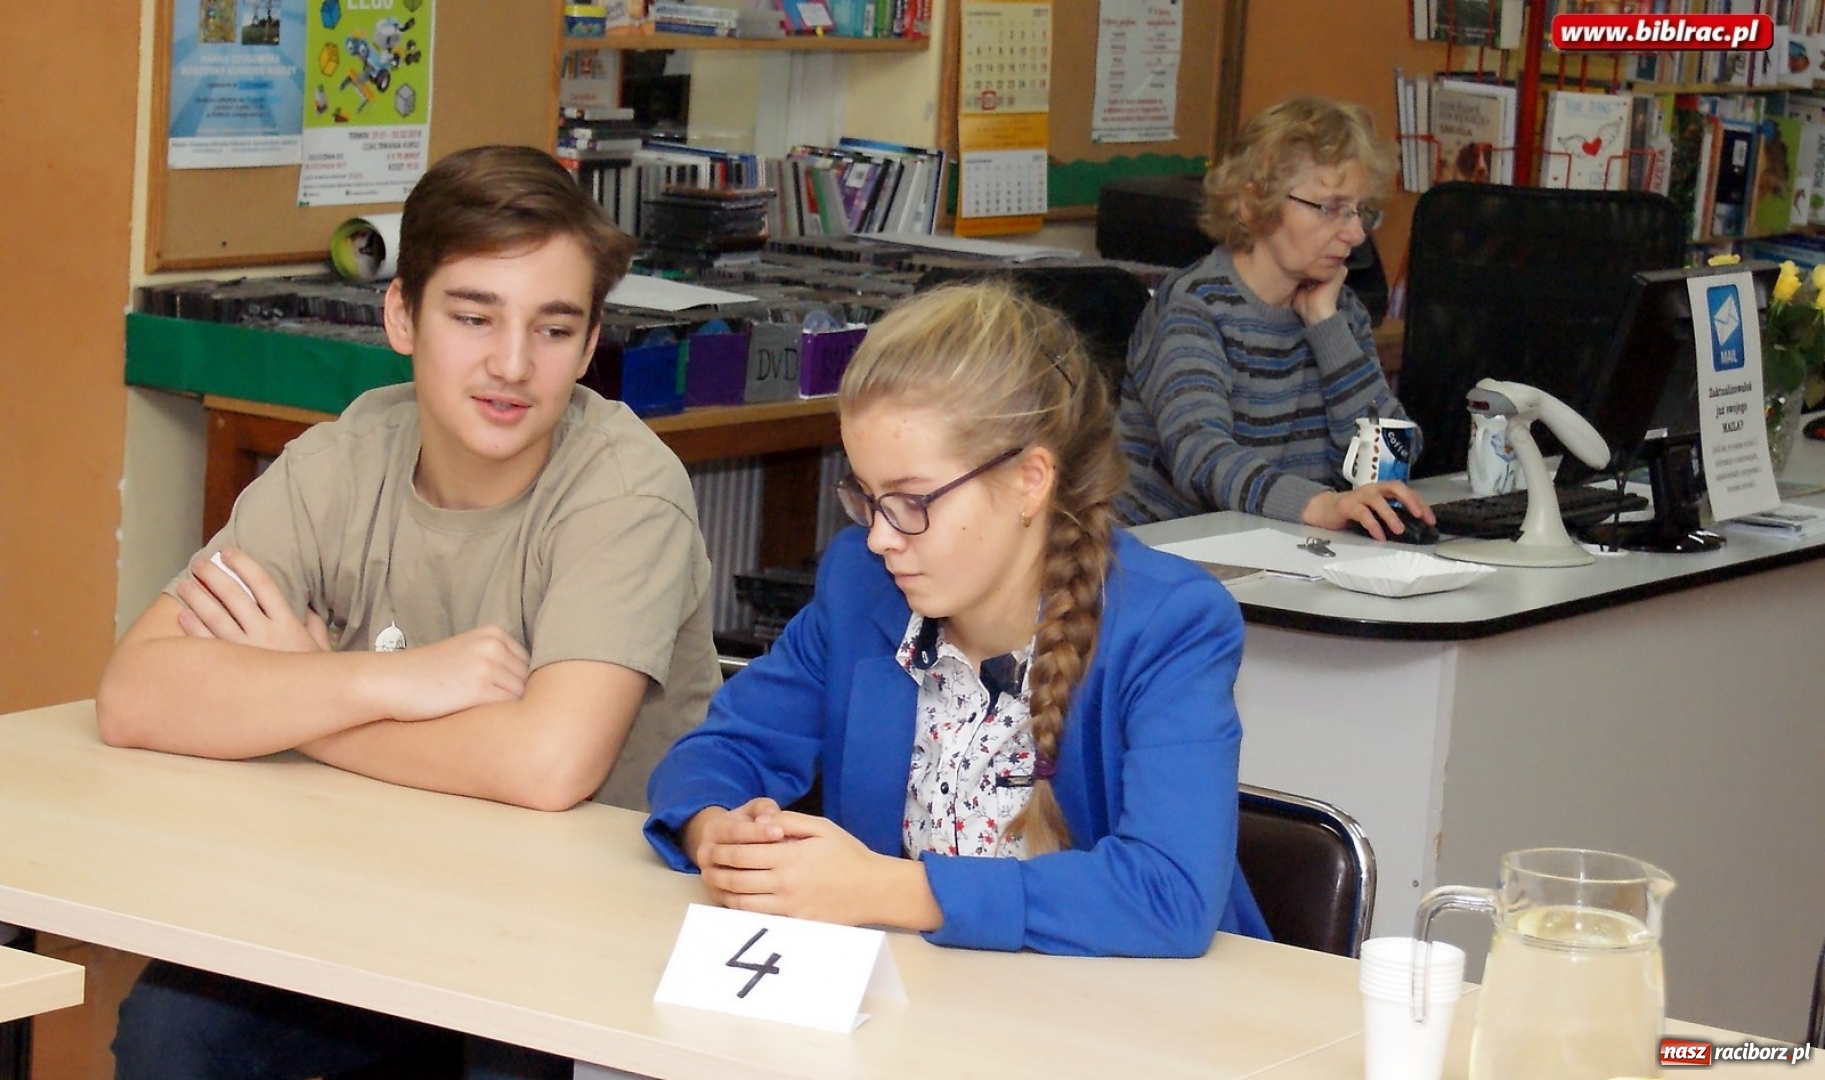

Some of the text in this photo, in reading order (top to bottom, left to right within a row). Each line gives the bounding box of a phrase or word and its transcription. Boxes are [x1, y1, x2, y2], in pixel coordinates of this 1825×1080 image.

[756, 348, 798, 381] DVD
[1720, 350, 1738, 364] MAIL
[725, 927, 782, 999] 4
